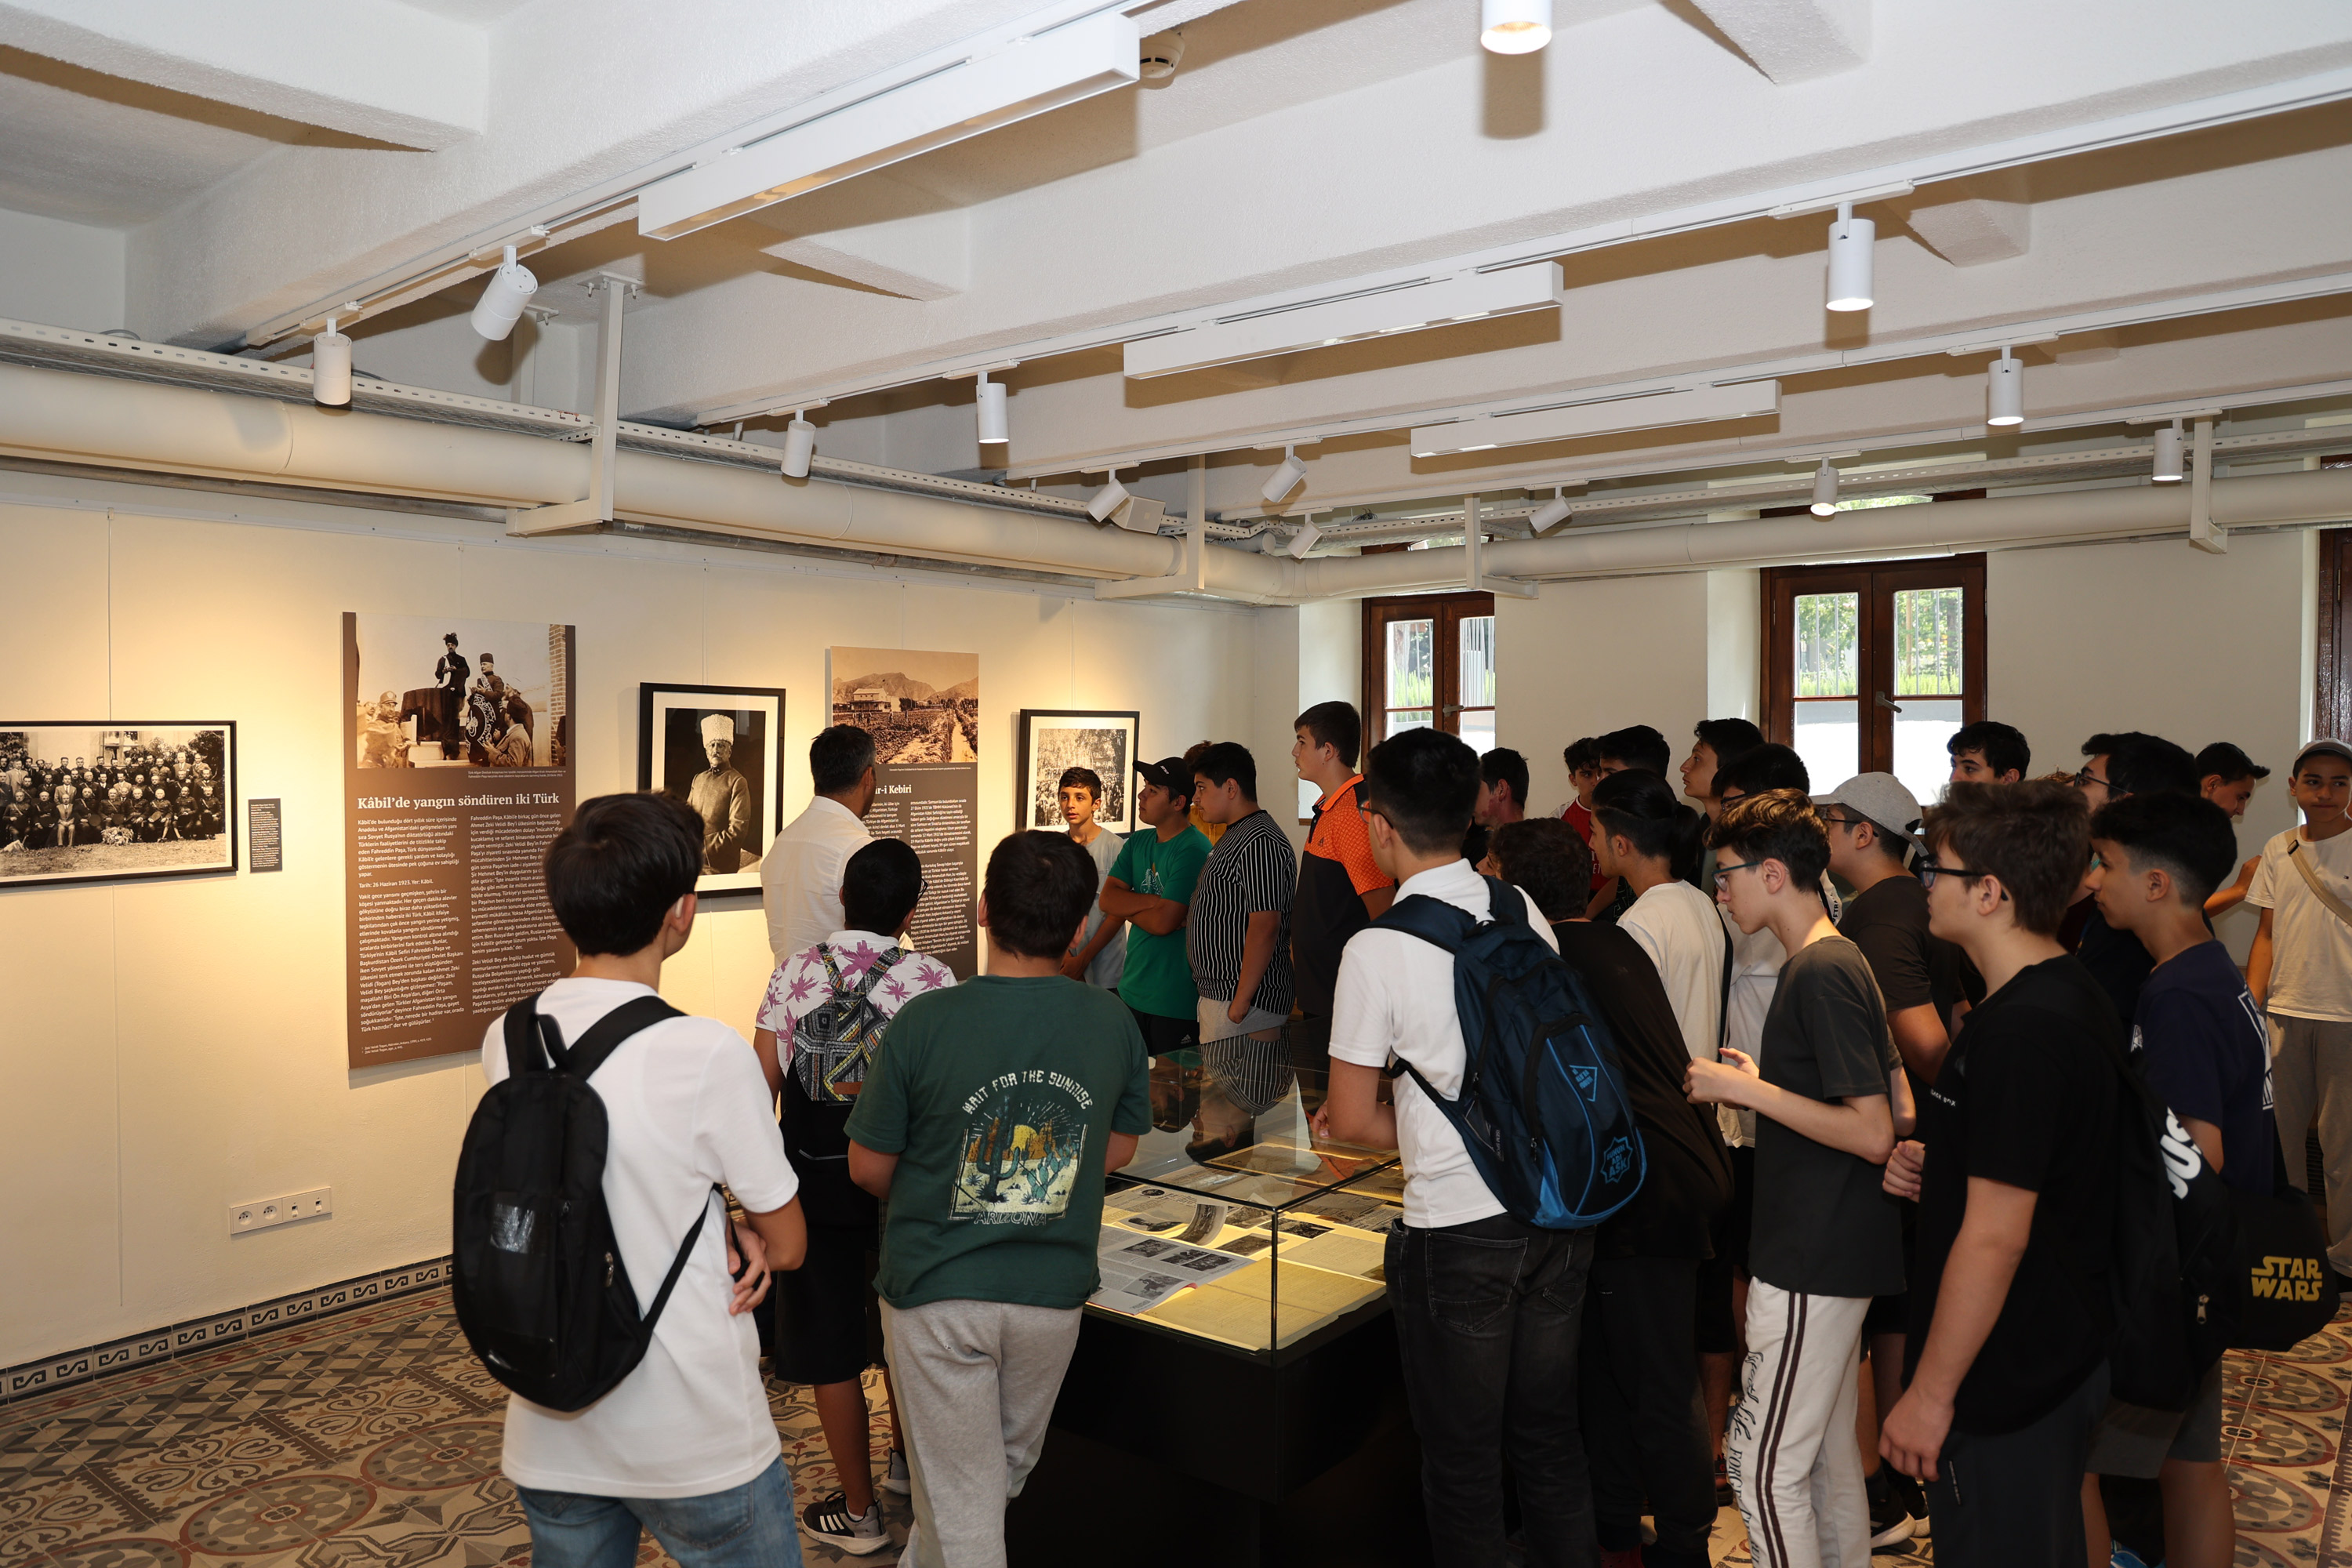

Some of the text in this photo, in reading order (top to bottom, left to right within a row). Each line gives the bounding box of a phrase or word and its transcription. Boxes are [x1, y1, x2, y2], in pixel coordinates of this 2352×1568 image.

[889, 784, 912, 793] Kebiri
[358, 793, 560, 810] Kâbil’de yangın söndüren iki Türk
[358, 862, 387, 871] göstermenin
[358, 907, 383, 916] gökyüzüne
[419, 924, 446, 932] söndürmeye
[391, 934, 411, 942] Yangının
[404, 953, 430, 963] Cumhuriyeti
[962, 1086, 989, 1116] WAIT
[992, 1073, 1018, 1092] FOR
[1021, 1069, 1044, 1083] THE
[2159, 1105, 2202, 1200] JUS
[2251, 1256, 2322, 1279] STAR
[2251, 1276, 2322, 1301] WARS
